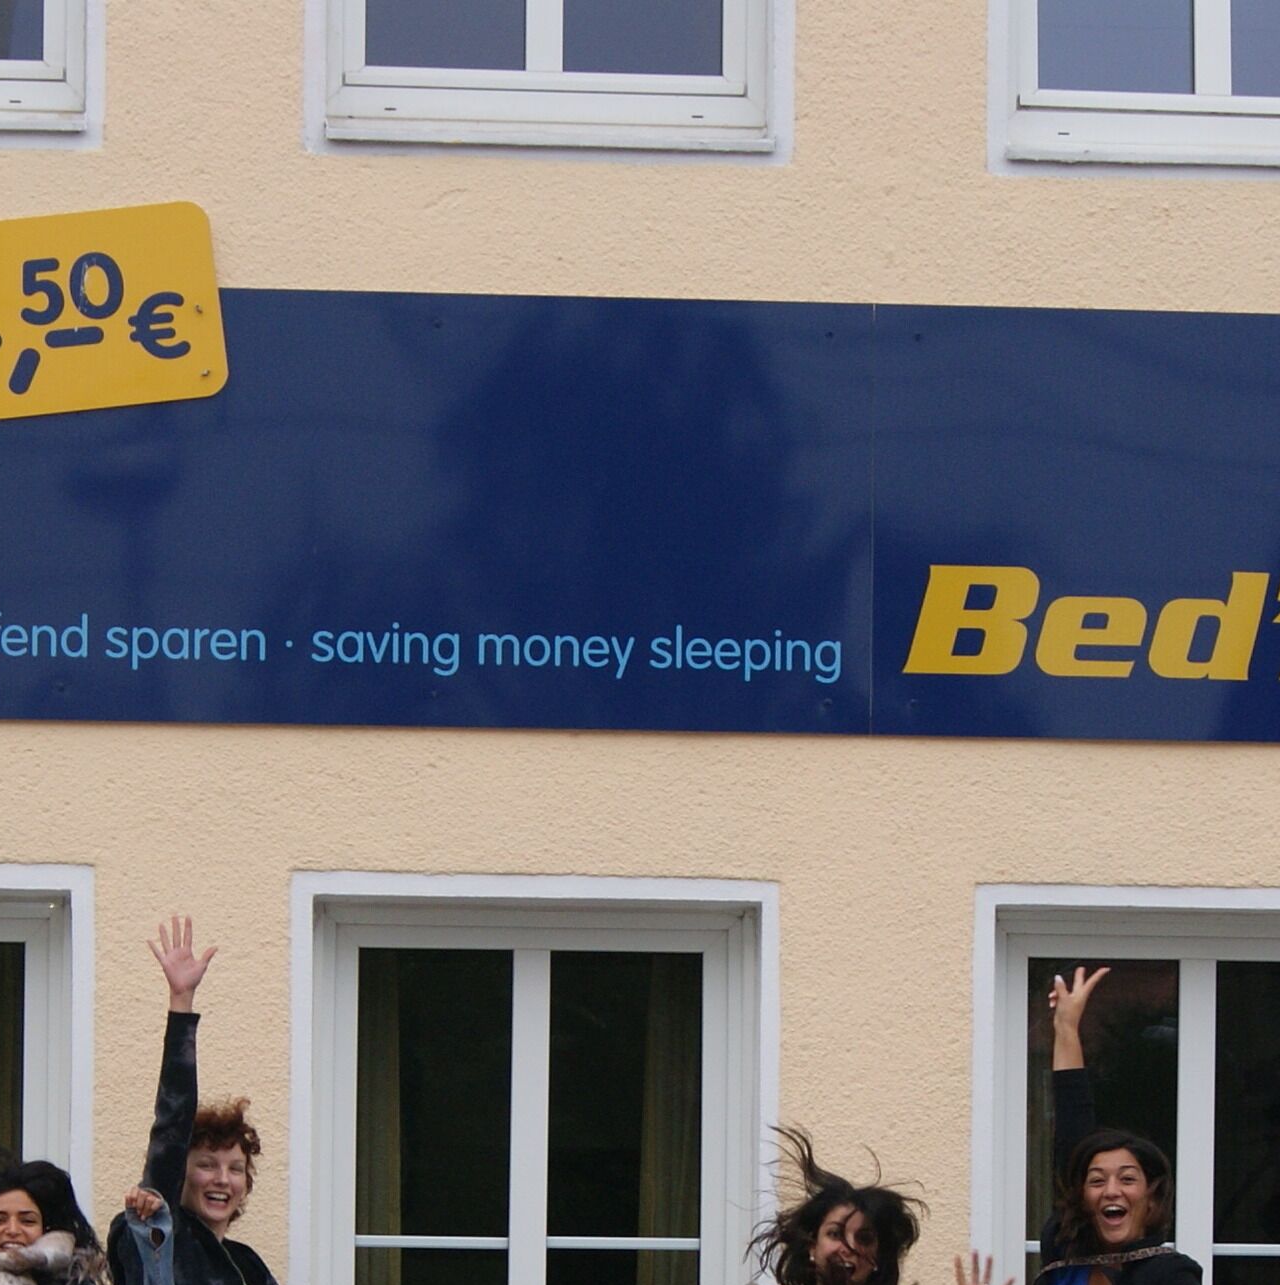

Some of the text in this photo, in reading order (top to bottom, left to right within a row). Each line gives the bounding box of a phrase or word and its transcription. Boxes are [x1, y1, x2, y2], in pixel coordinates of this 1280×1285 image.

[104, 625, 268, 671] sparen
[310, 621, 461, 677] saving
[477, 633, 636, 680] money
[649, 624, 842, 685] sleeping
